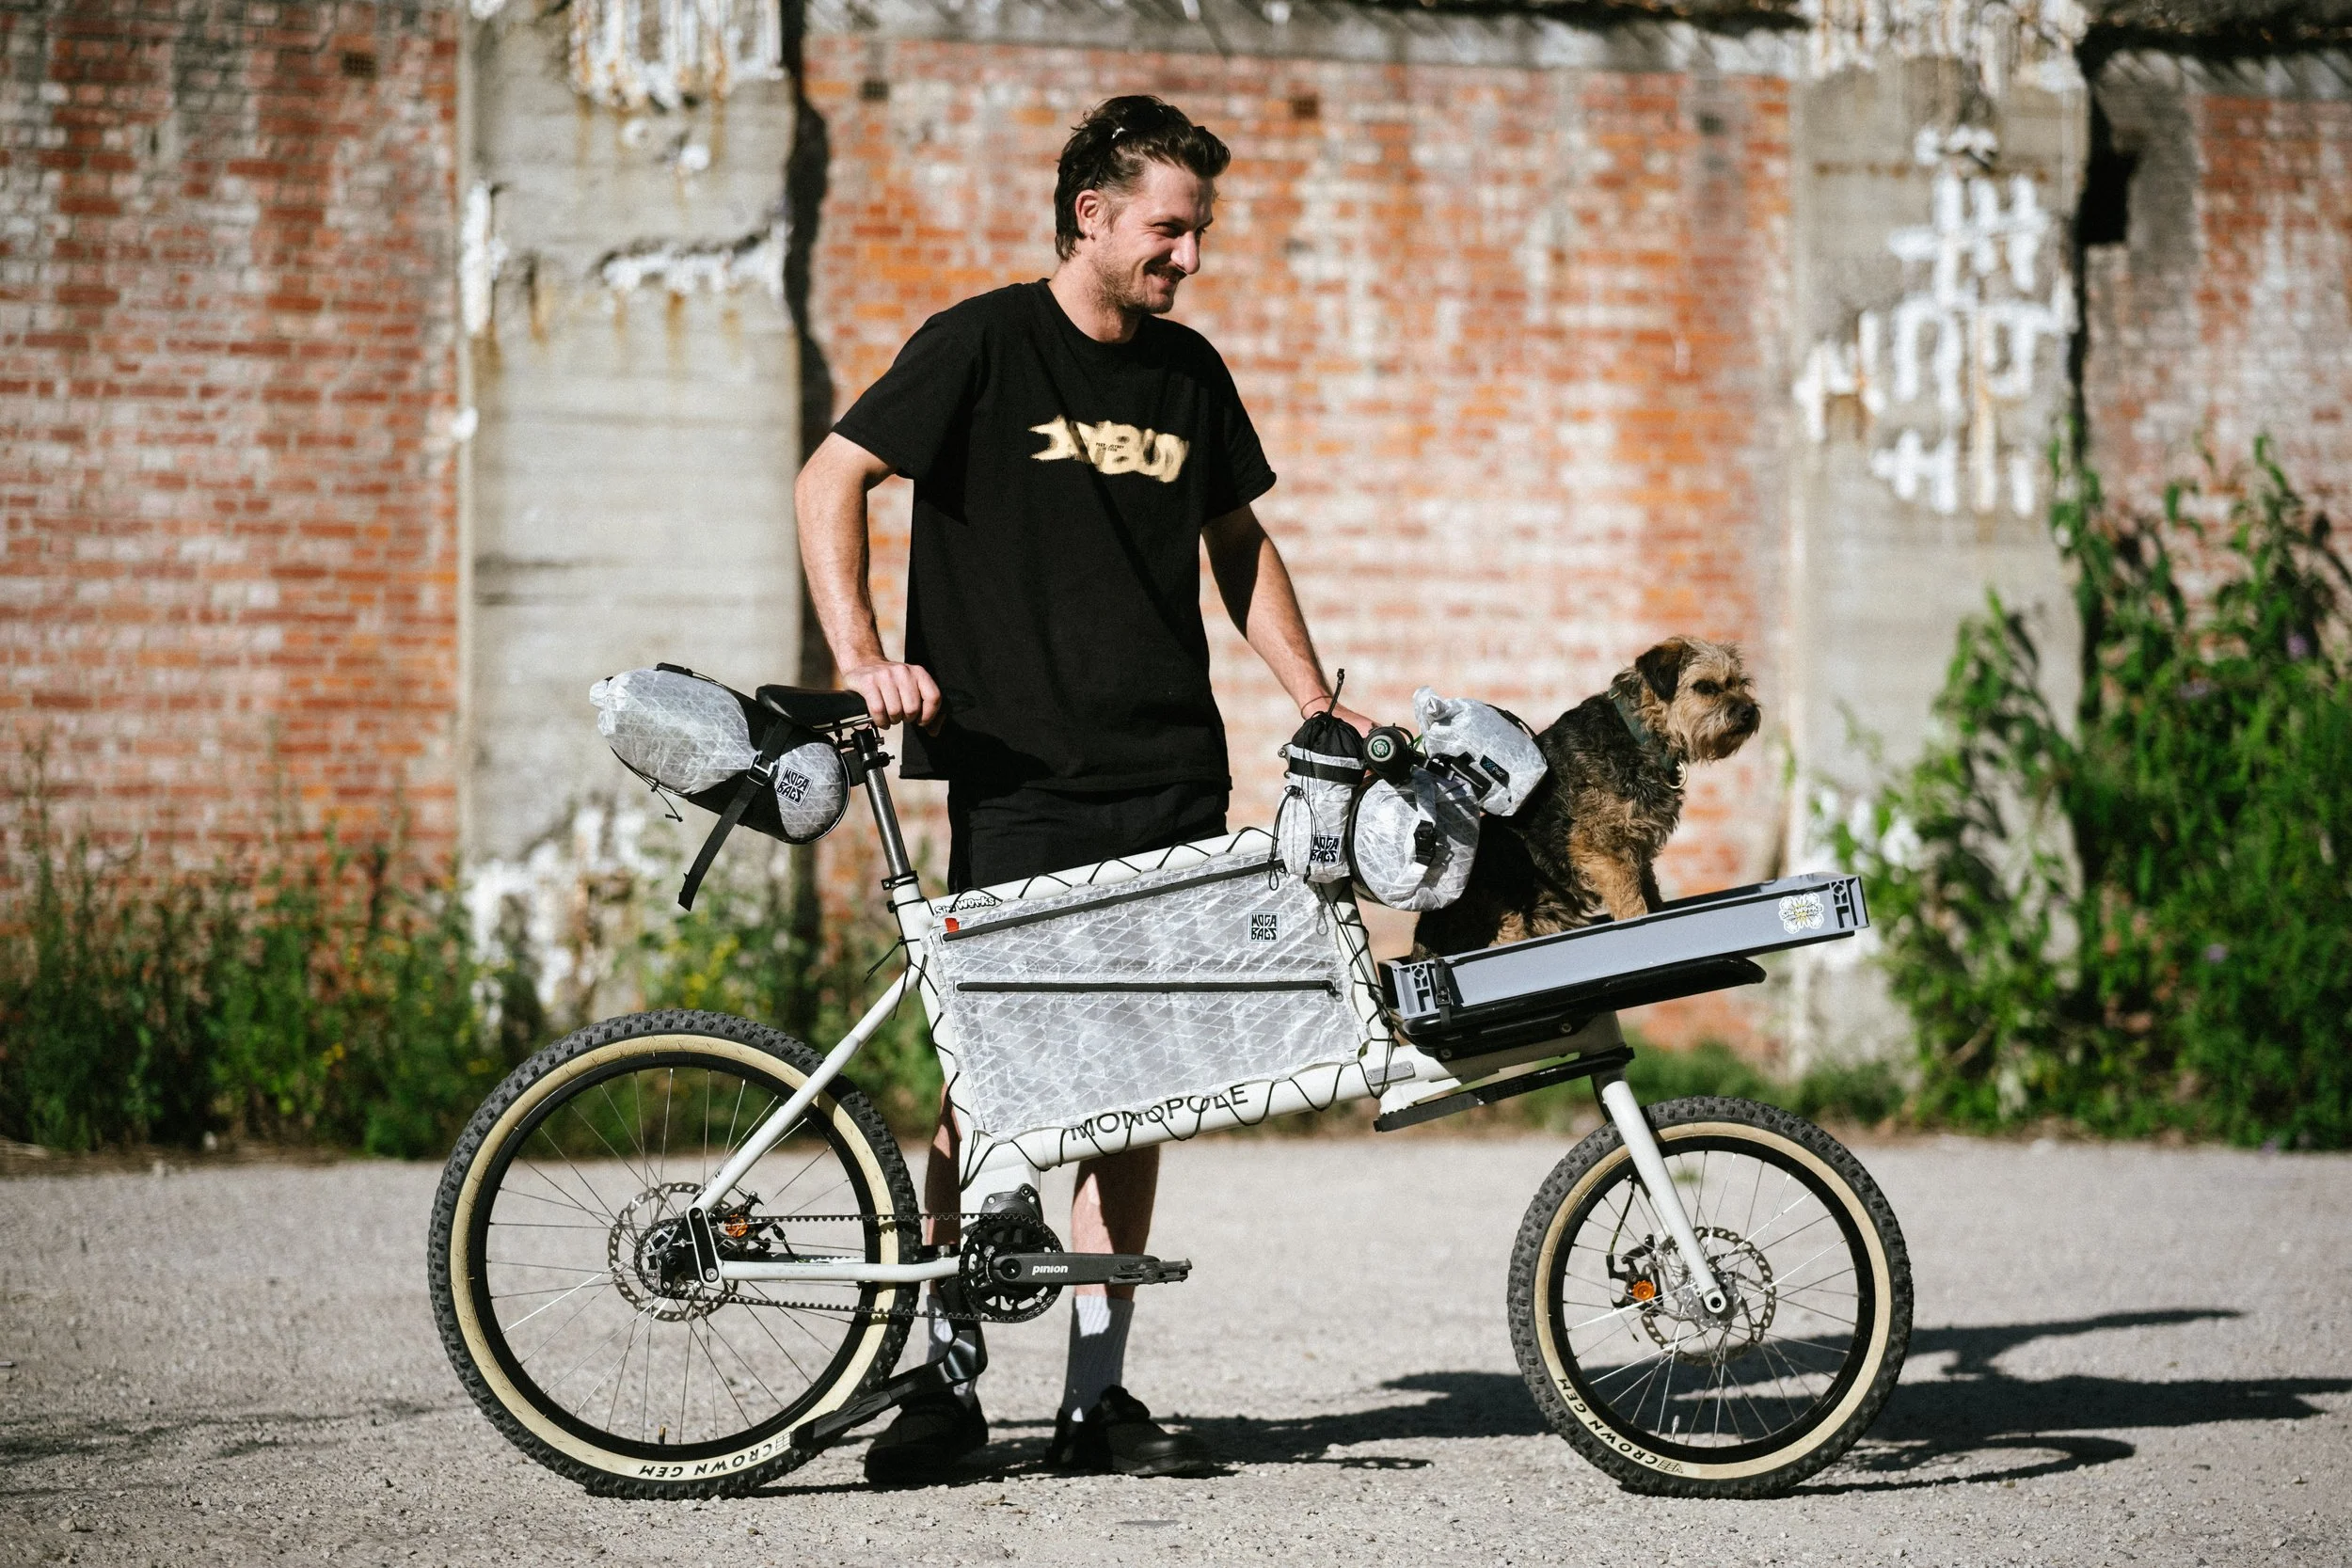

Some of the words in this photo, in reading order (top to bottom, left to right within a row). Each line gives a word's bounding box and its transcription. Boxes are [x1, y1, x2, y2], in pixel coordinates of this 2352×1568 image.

[783, 768, 810, 792] MOGA
[776, 782, 804, 803] BAGS
[1312, 836, 1339, 850] MOGA
[1311, 849, 1337, 863] BAGS
[1251, 913, 1277, 927] MOGA
[1251, 927, 1277, 941] BAGS
[1071, 1084, 1248, 1141] MONOPOLE
[1031, 1265, 1069, 1276] pinion
[1557, 1379, 1587, 1413] GEM
[1589, 1419, 1659, 1465] CROWN
[693, 1443, 772, 1476] CROWN
[638, 1465, 684, 1478] GEM
